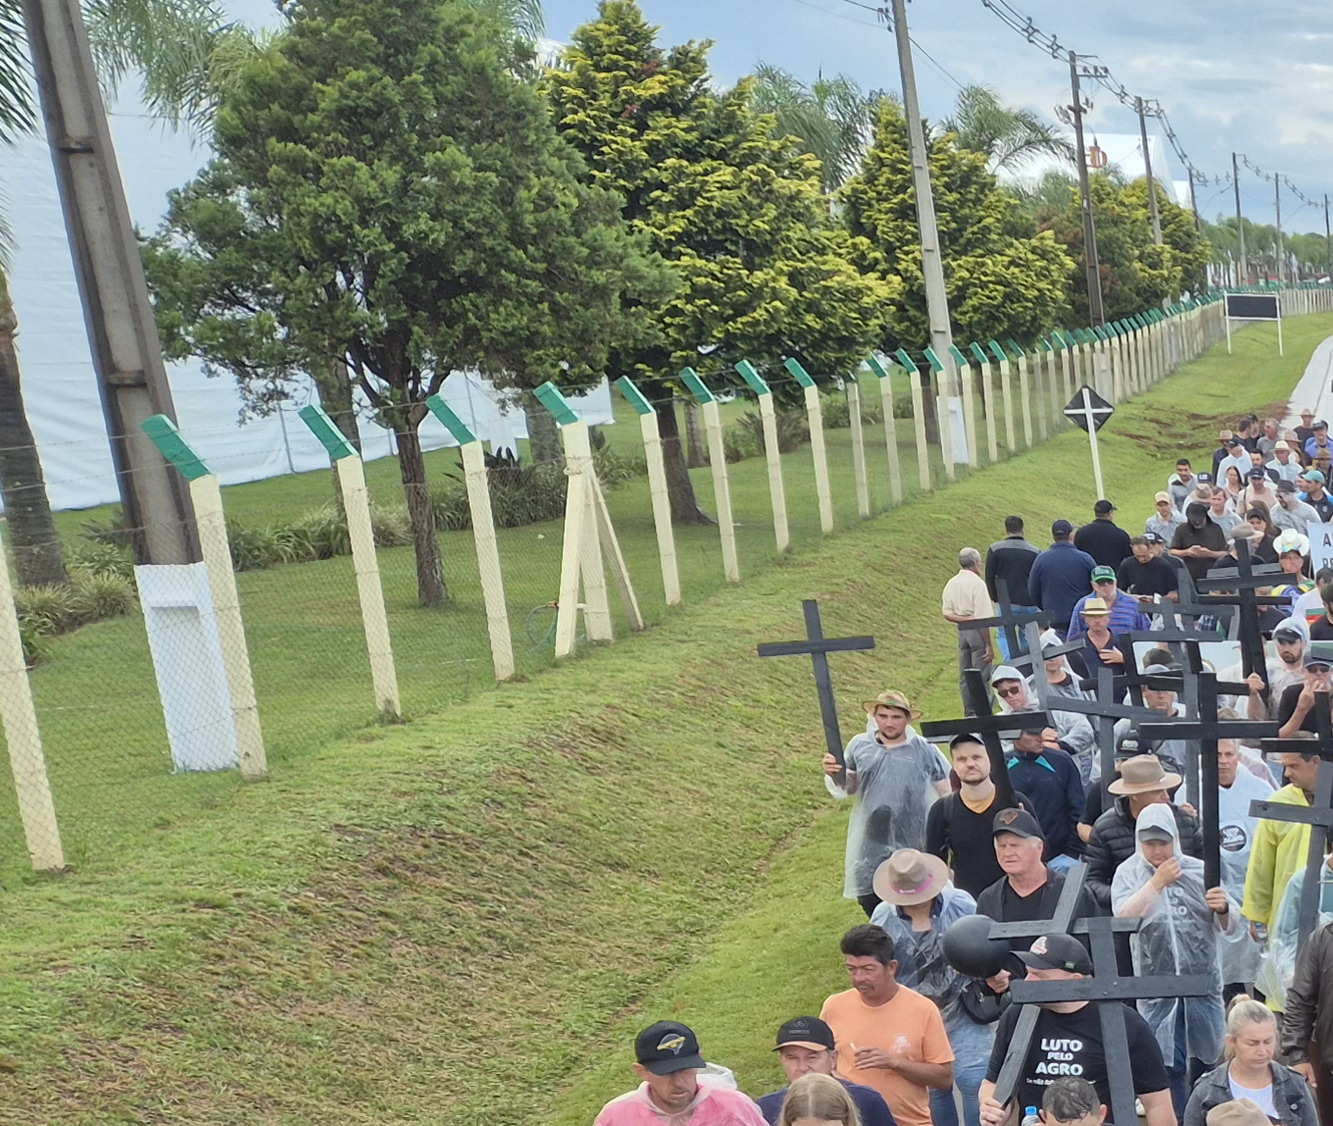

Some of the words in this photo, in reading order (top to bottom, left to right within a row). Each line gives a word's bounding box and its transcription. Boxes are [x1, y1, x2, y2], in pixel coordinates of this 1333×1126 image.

[1040, 1038, 1083, 1052] LUTO
[1047, 1051, 1074, 1061] PELO
[1035, 1061, 1084, 1076] AGRO
